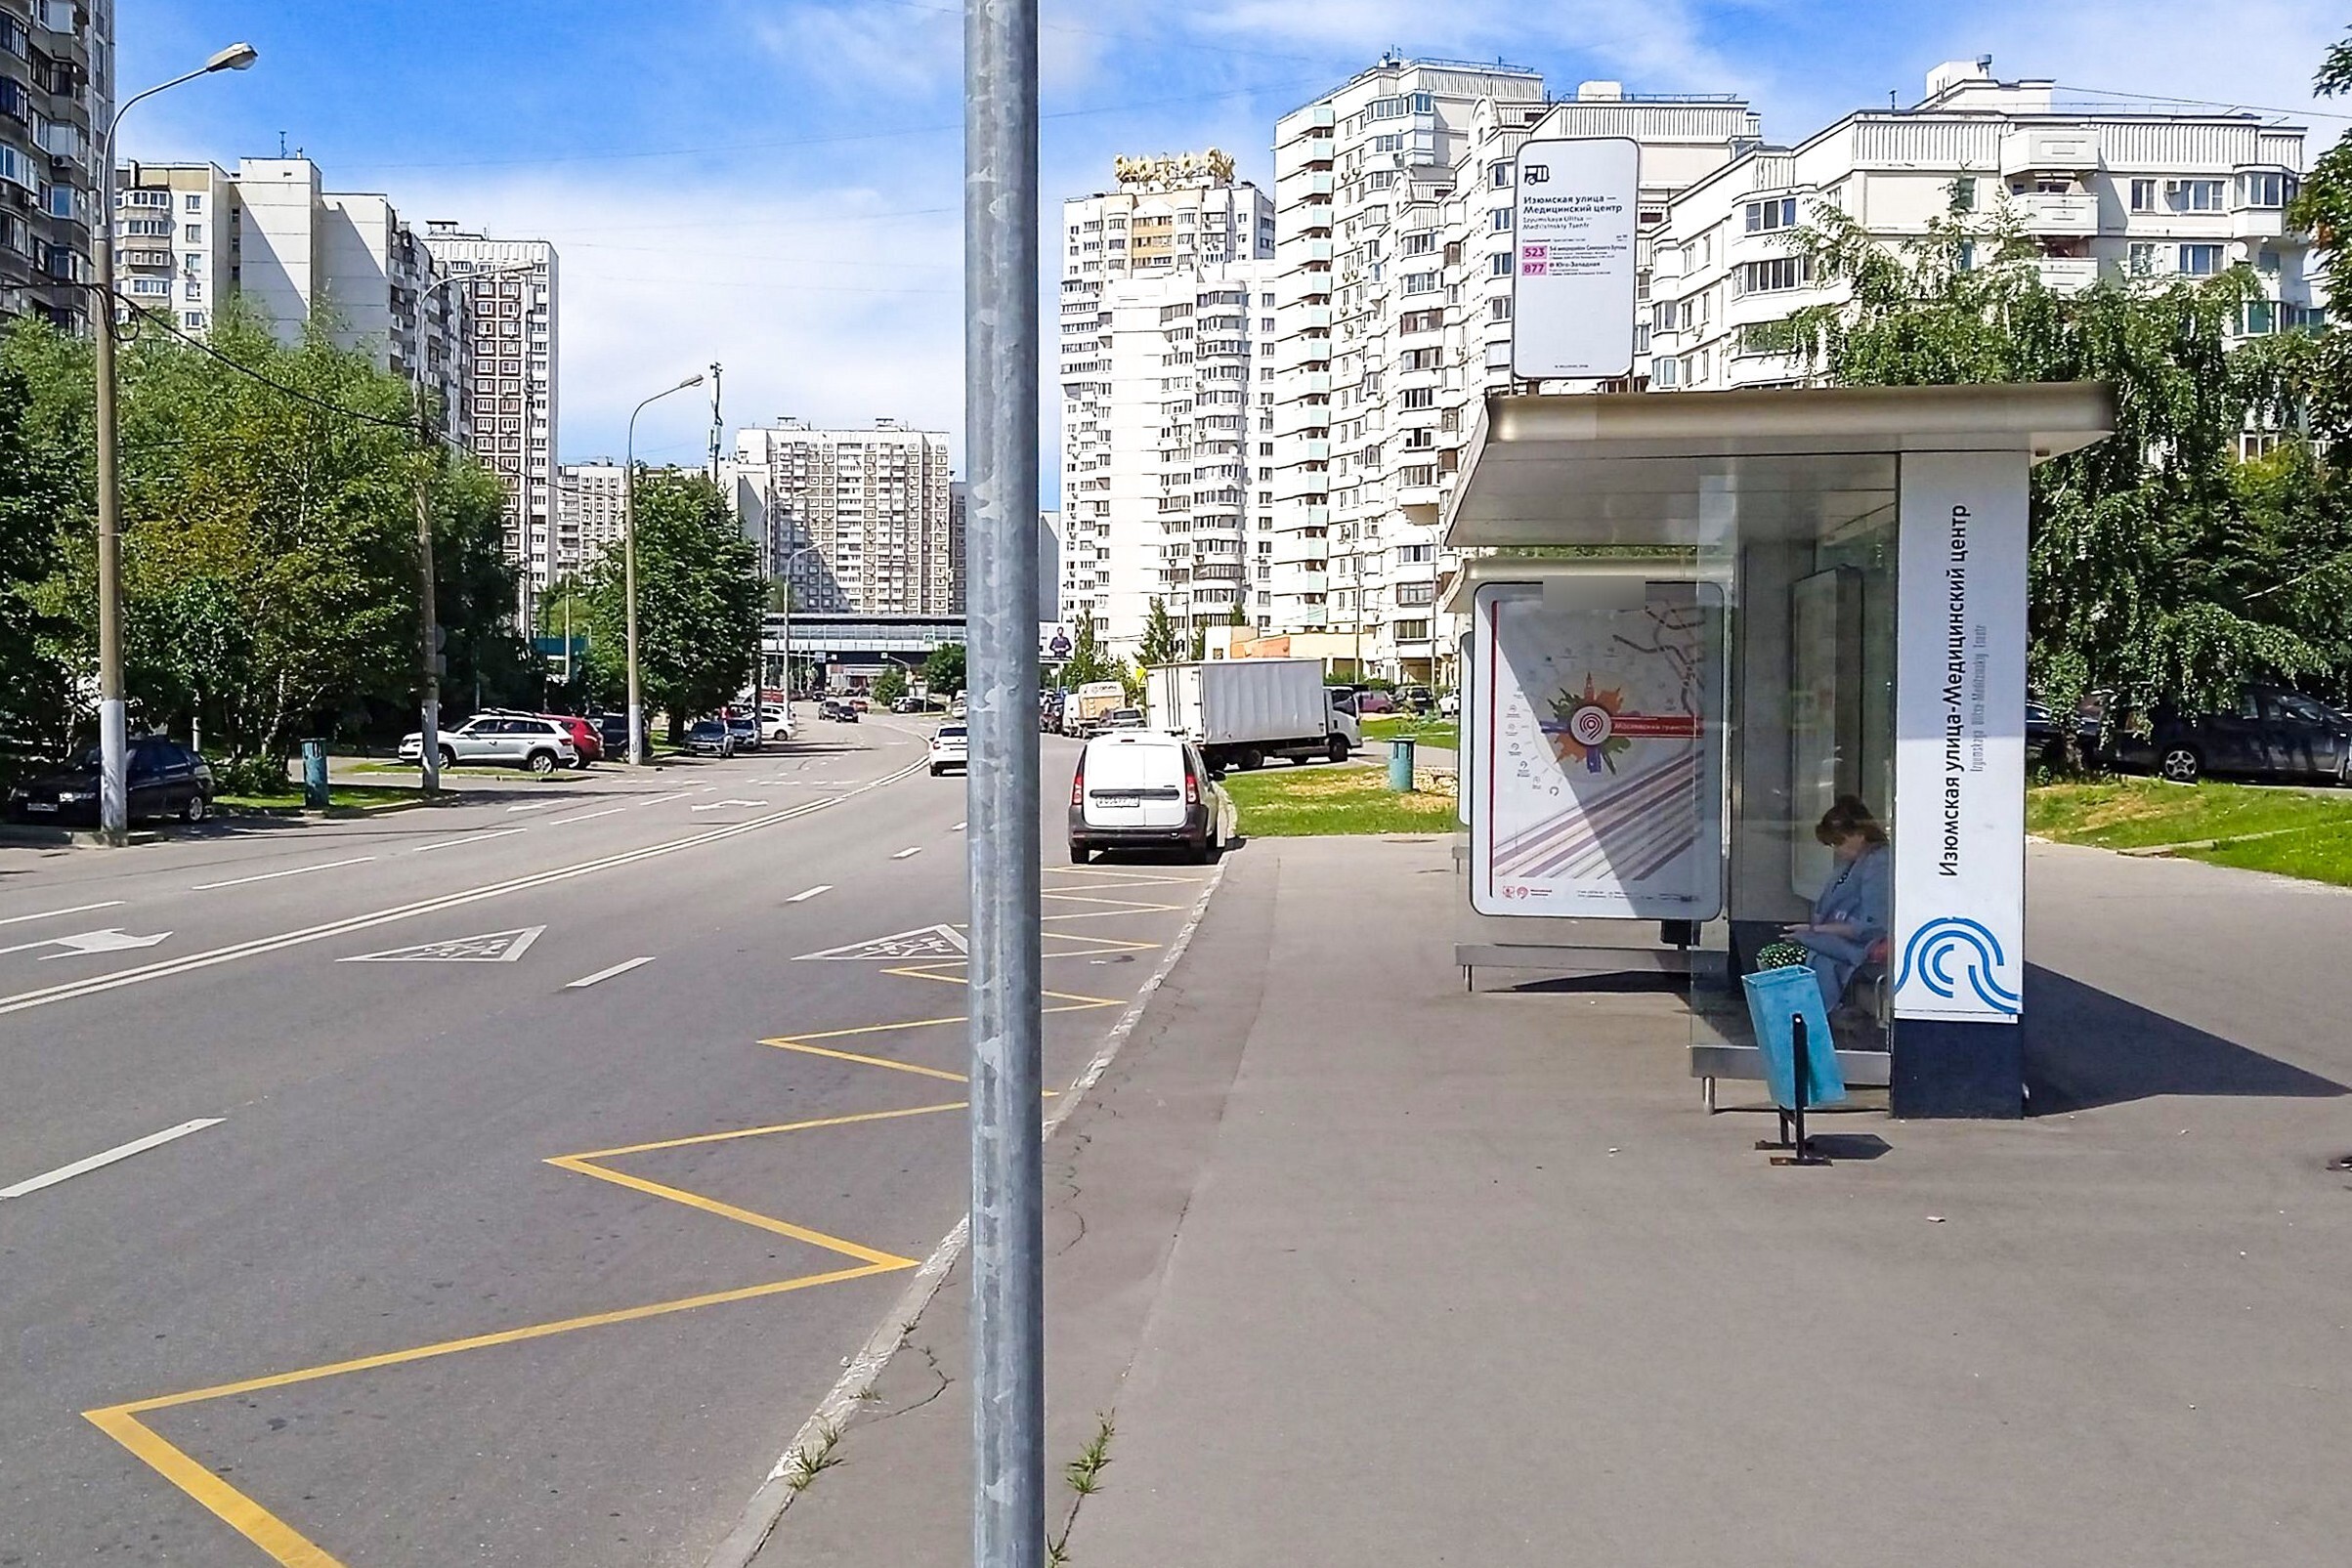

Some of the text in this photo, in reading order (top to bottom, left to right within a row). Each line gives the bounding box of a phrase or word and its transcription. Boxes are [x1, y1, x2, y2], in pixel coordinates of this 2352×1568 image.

[1575, 195, 1604, 204] улица
[1523, 204, 1592, 214] Медицинский
[1524, 247, 1545, 257] 523
[1524, 264, 1545, 274] 877
[1939, 504, 1971, 876] Изюмская улица-Медицинский центр
